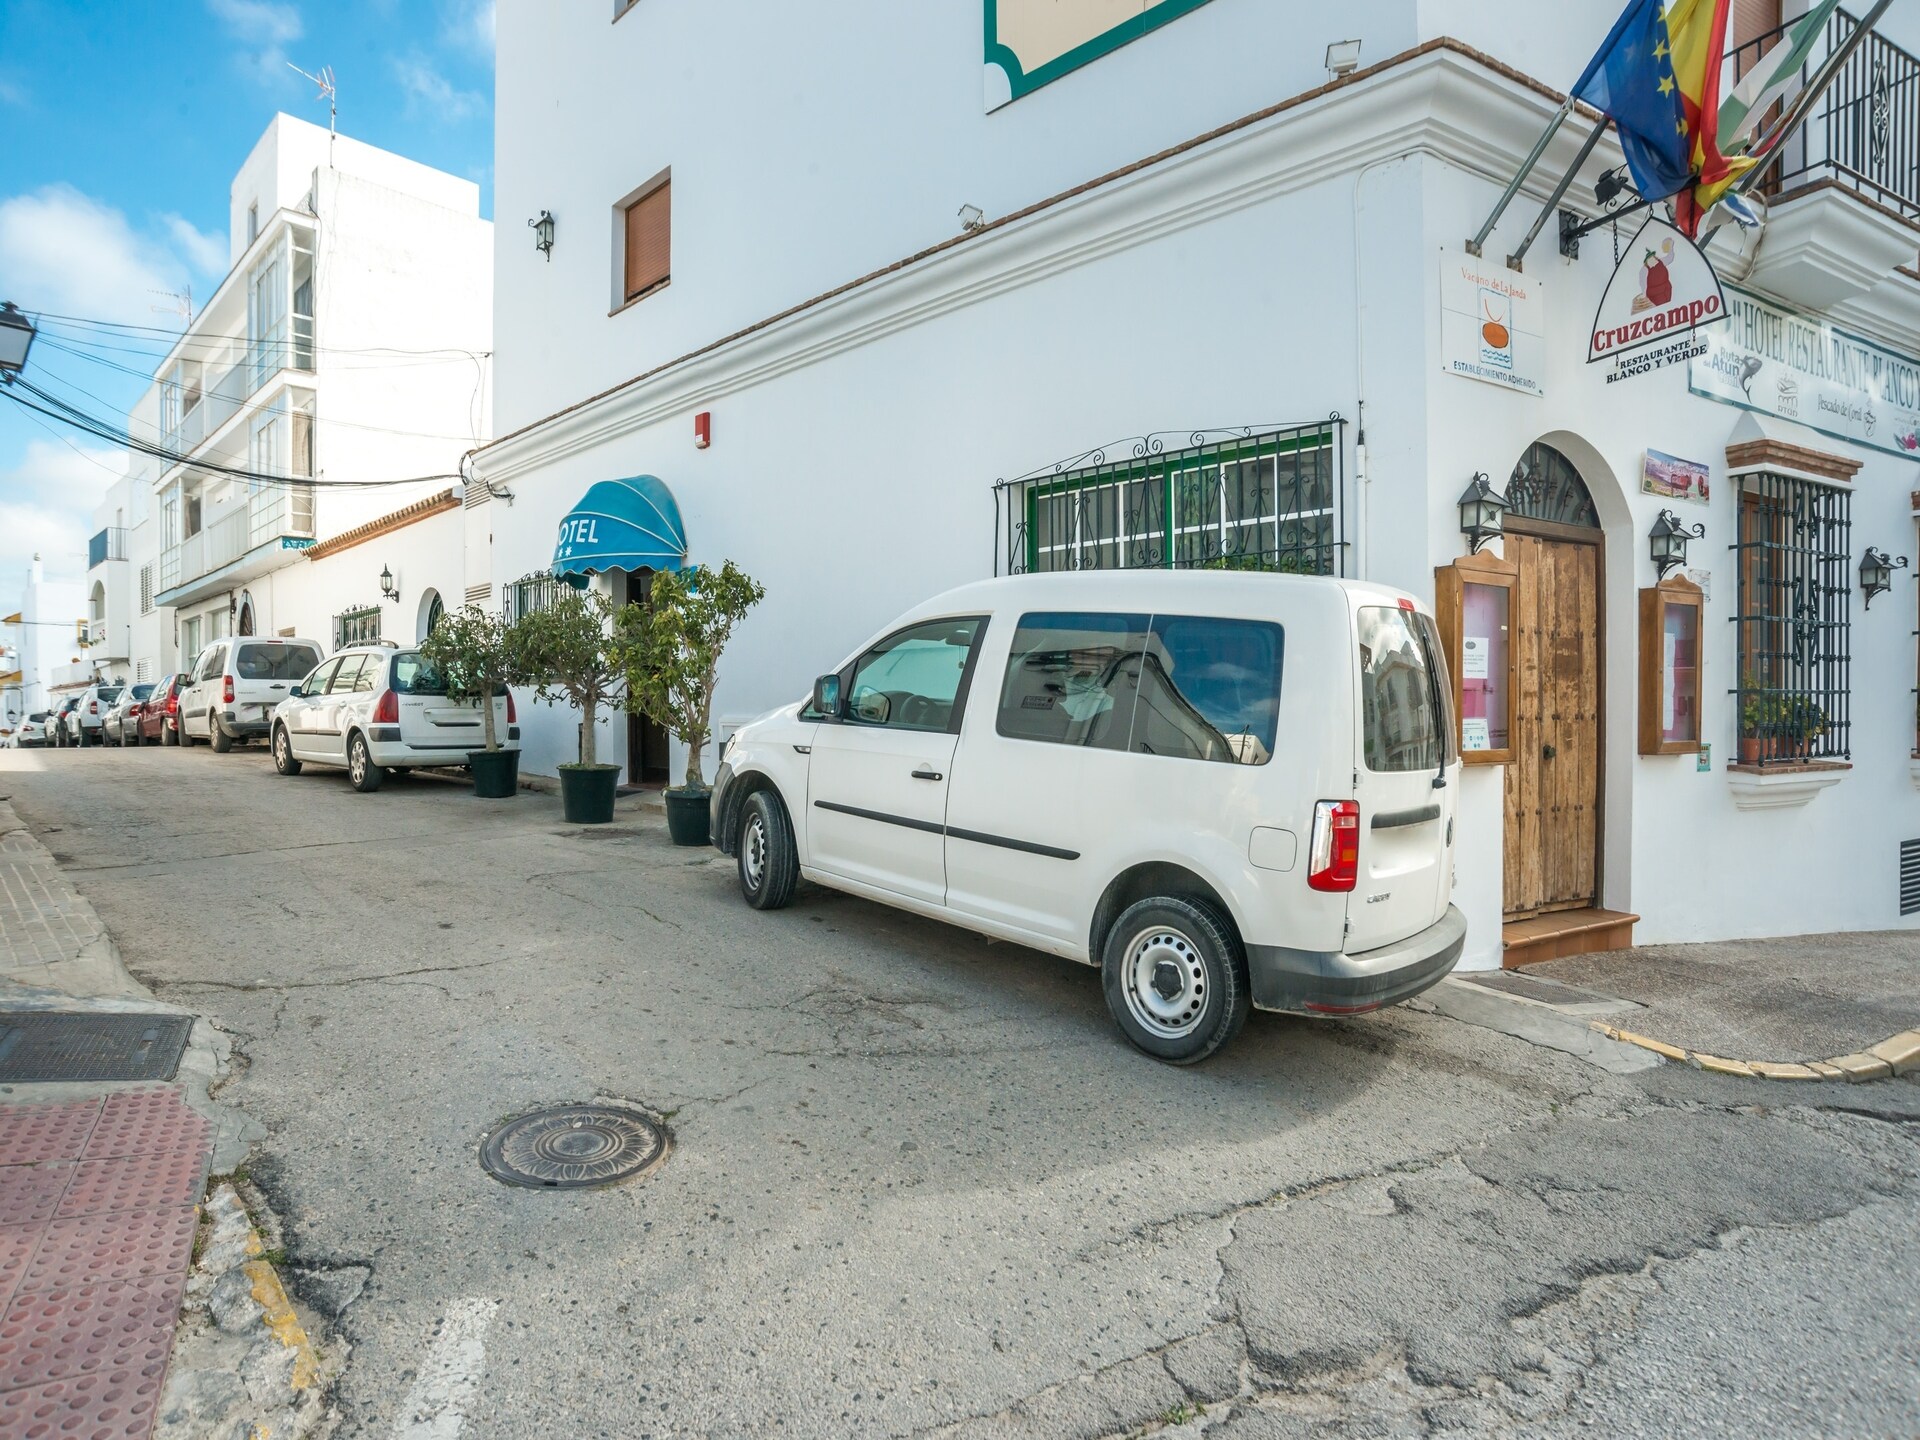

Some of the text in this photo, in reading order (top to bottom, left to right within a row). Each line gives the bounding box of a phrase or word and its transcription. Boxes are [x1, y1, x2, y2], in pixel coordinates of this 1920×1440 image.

[1491, 278, 1499, 290] de
[1500, 281, 1508, 293] La
[1509, 285, 1526, 300] Janda
[1593, 295, 1719, 352] Cruzcampo
[1606, 344, 1708, 384] BLANCO Y VERDE
[1620, 340, 1691, 369] RESTAURANTE
[1720, 346, 1740, 364] Ruta
[1788, 321, 1869, 394] RESTAURANTE
[1453, 361, 1536, 389] ESTABLECIMIENTO ADHERIDO
[1841, 402, 1847, 416] de
[559, 519, 599, 546] OTEL
